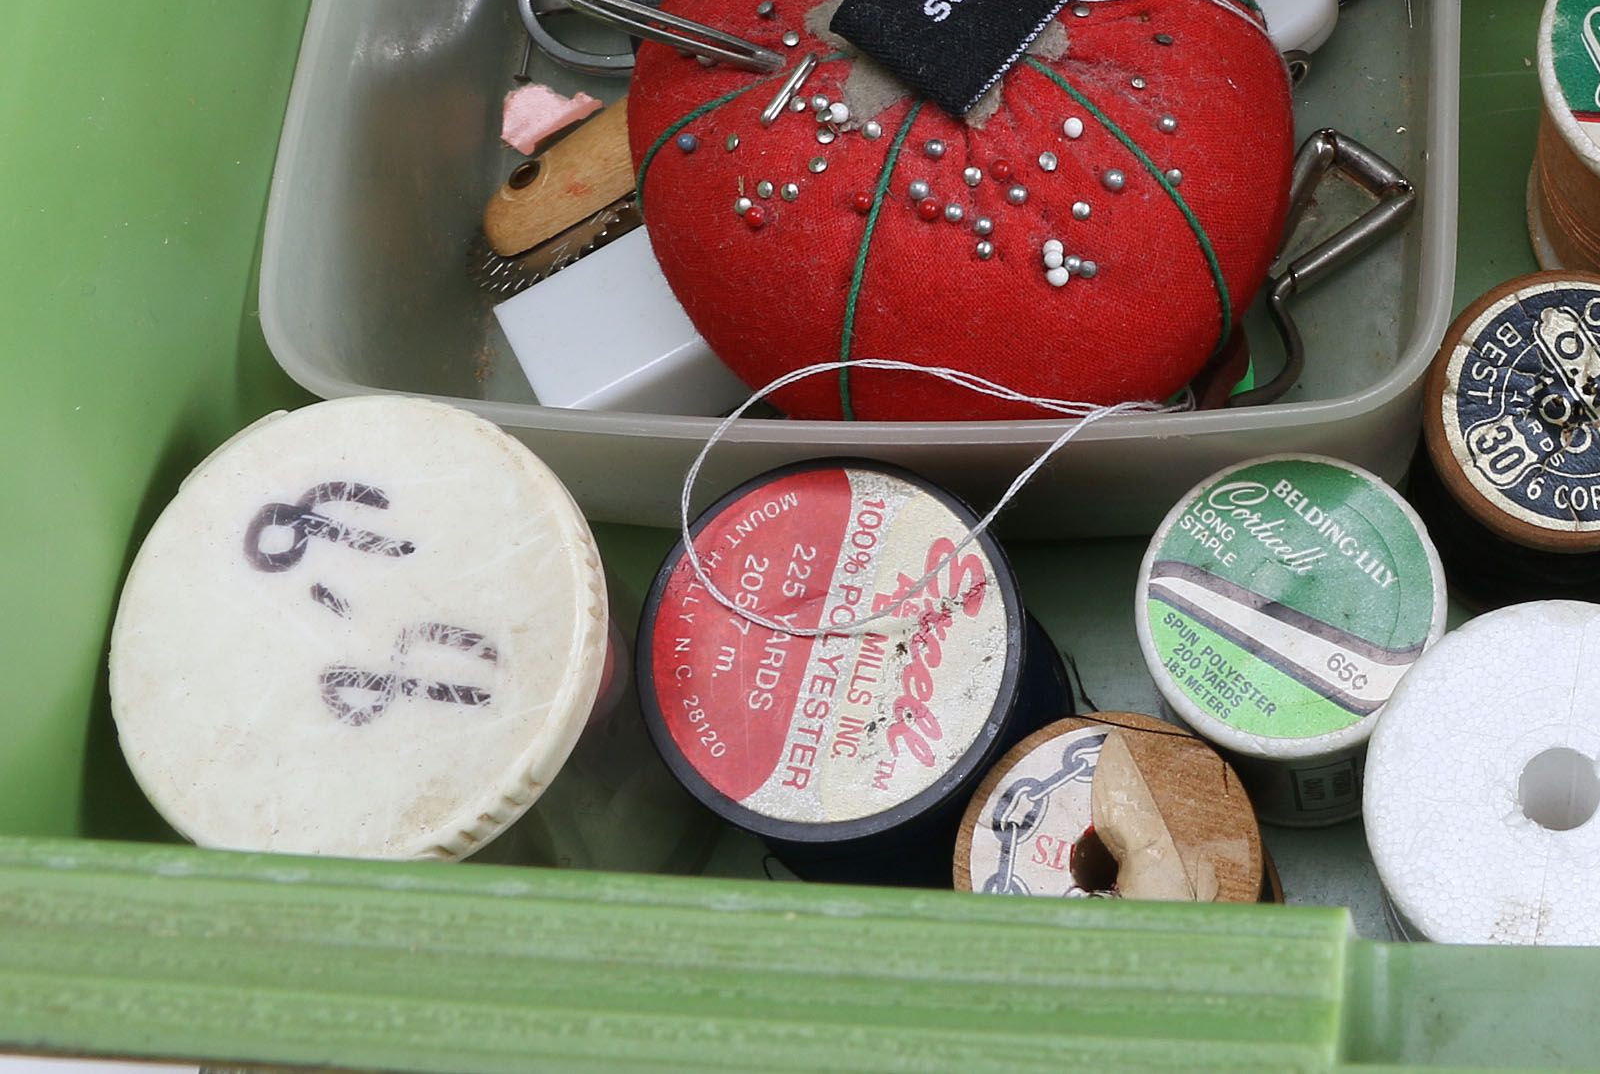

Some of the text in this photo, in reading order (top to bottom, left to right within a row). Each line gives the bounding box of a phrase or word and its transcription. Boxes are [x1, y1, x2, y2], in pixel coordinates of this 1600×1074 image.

[1467, 322, 1523, 405] BEST
[1475, 425, 1526, 476] 30
[1527, 477, 1545, 500] 6
[728, 492, 799, 549] MOUNT
[1179, 514, 1238, 567] STAPLE
[1192, 501, 1237, 542] LONG
[748, 543, 817, 711] 225 YARDS
[781, 497, 886, 791] 100% POLYESTER
[674, 638, 692, 687] N.C.
[1162, 611, 1278, 717] SPUN POLYESTER
[1165, 657, 1231, 720] 183 METERS
[1172, 642, 1244, 709] 200 YARDS
[1326, 653, 1369, 691] 65¢
[682, 696, 725, 759] 28120
[829, 634, 885, 760] MILLS INC.
